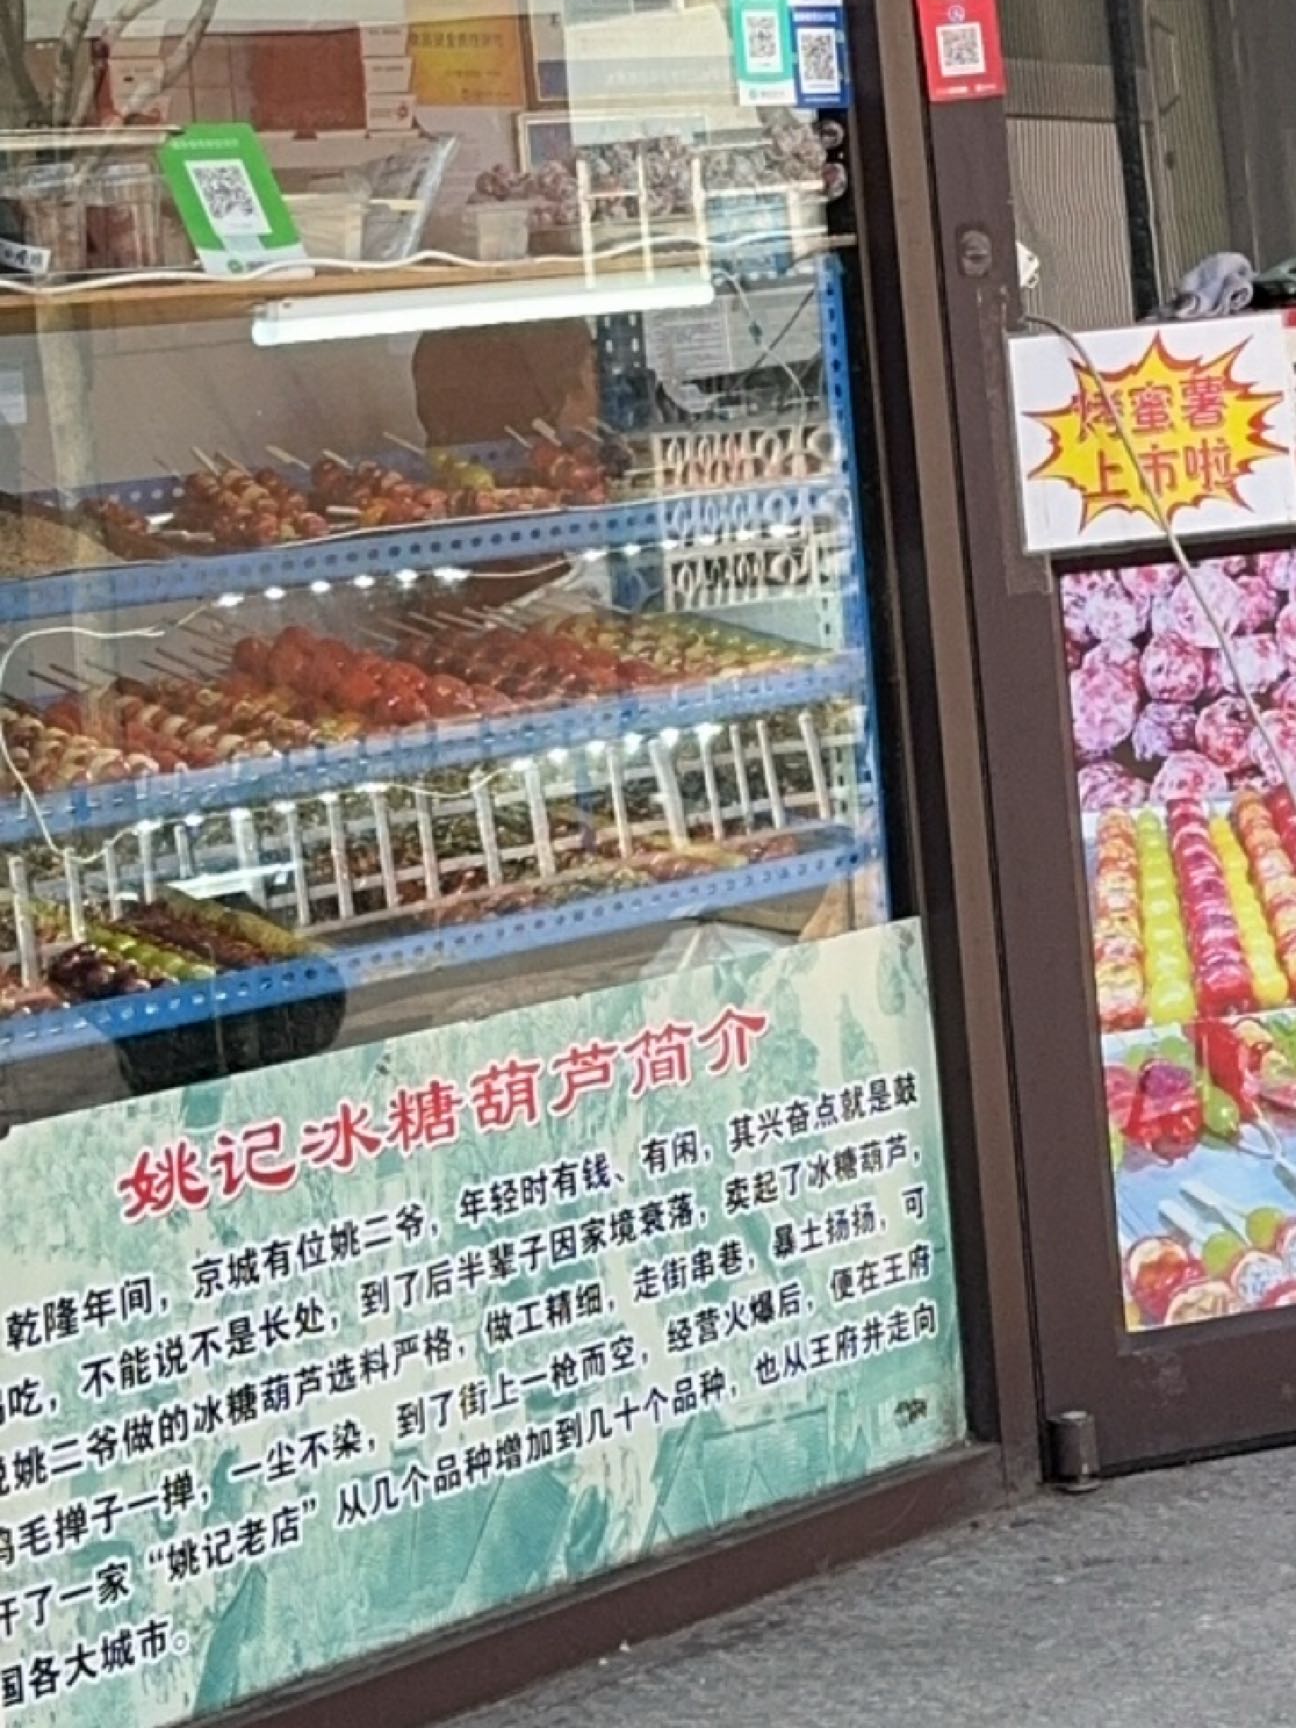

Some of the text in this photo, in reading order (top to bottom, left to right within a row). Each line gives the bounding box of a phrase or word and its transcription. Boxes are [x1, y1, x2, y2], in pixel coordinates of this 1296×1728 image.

[1072, 373, 1229, 445] 烤蜜薯
[1083, 436, 1233, 502] 上市啦
[119, 1007, 767, 1220] 姚记冰糖葫芦简介
[0, 1134, 922, 1426] 吃，不能说不是长处，到了后半辈子因家境衰落，卖起了冰糖葫芦，
